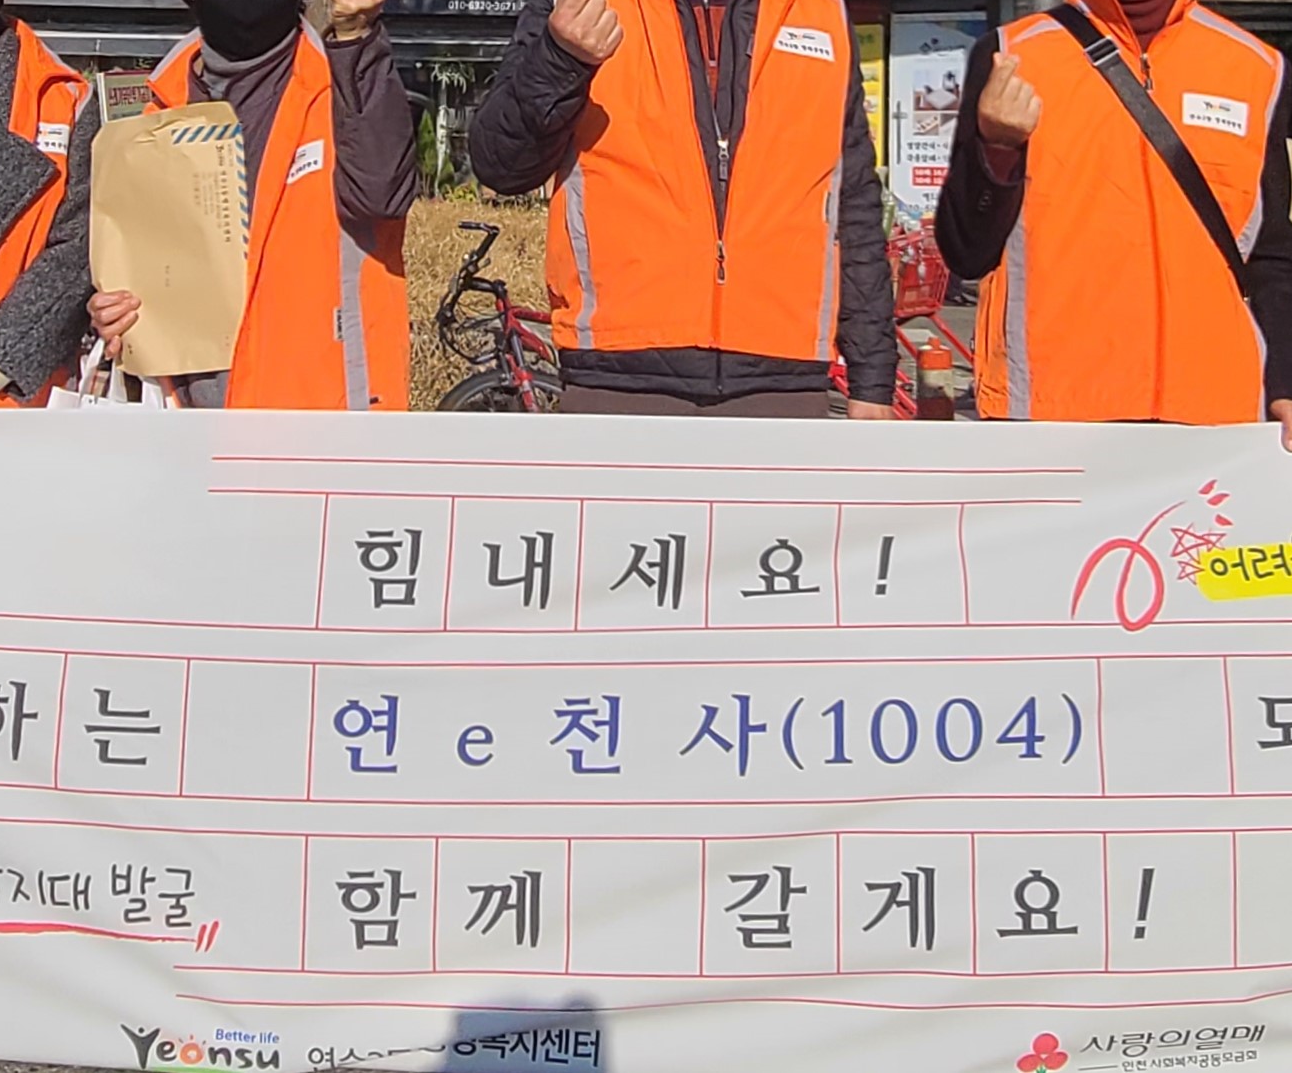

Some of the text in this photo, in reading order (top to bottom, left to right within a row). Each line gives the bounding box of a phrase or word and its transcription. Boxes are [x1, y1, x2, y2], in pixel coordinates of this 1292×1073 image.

[109, 862, 196, 929] 발굴
[333, 867, 543, 951] 함께
[120, 1023, 281, 1071] Yeonsu
[215, 1028, 281, 1044] Better life
[1079, 1024, 1267, 1058] 사랑의열매
